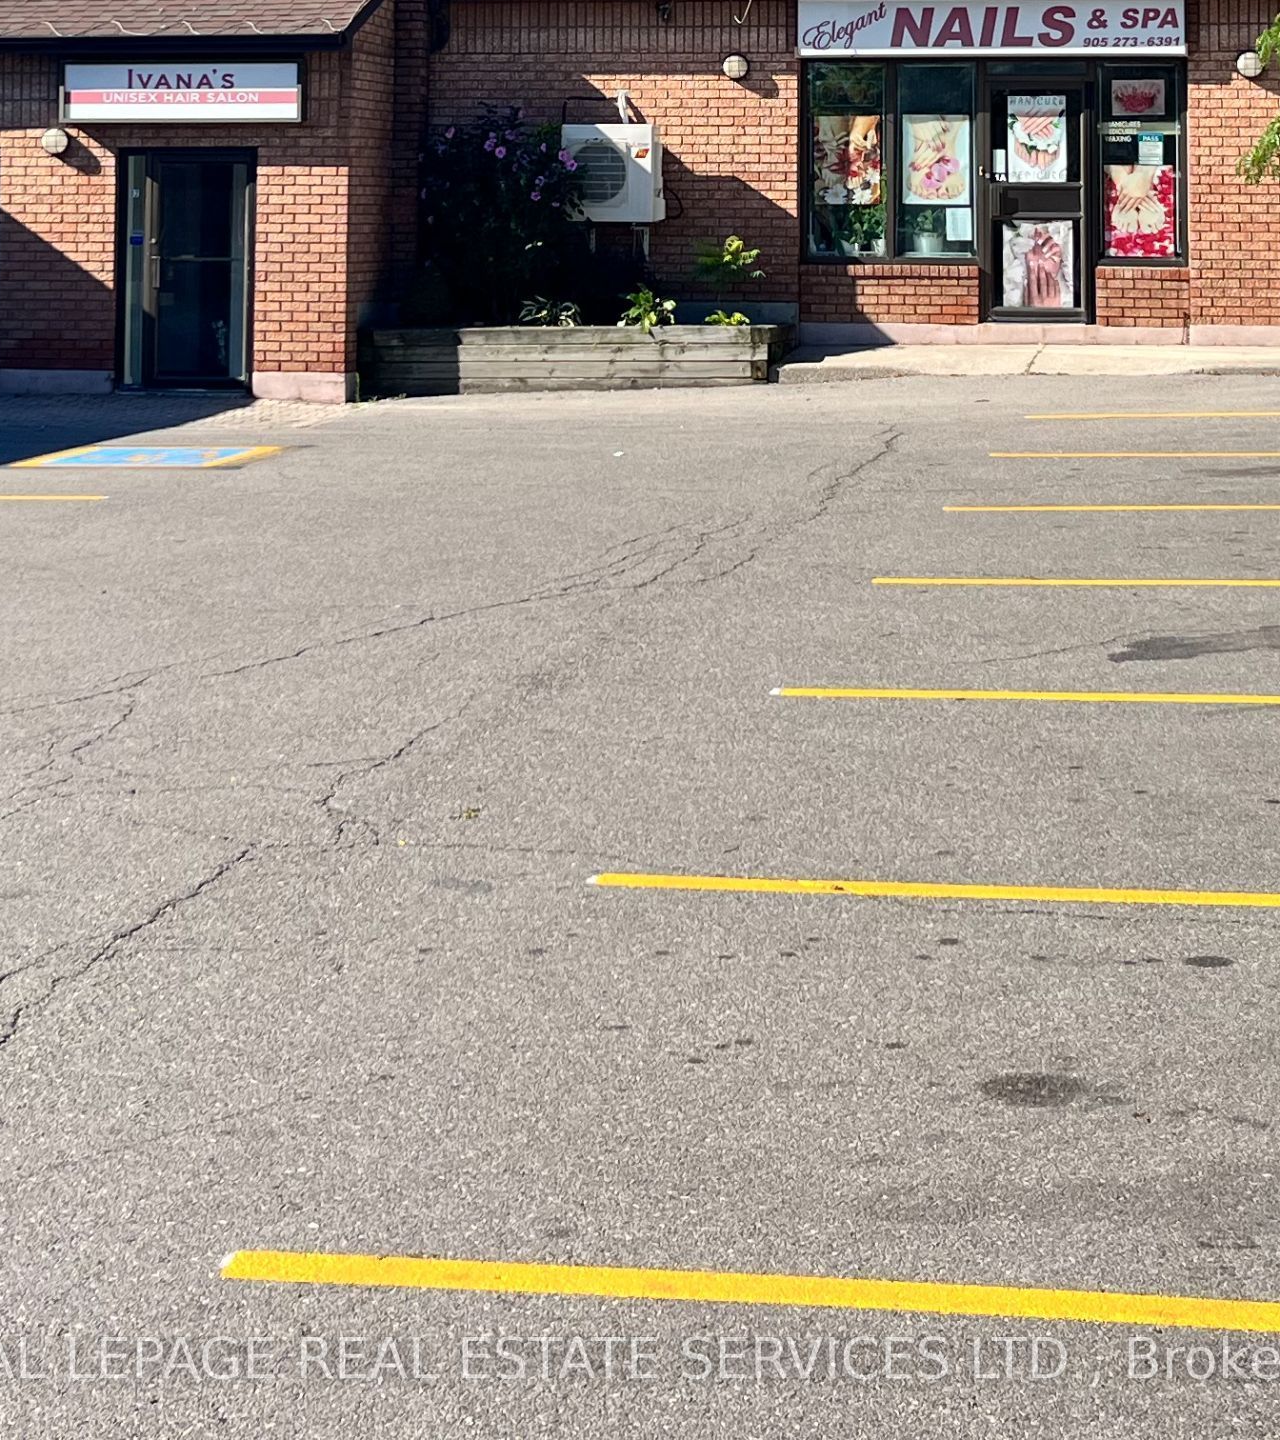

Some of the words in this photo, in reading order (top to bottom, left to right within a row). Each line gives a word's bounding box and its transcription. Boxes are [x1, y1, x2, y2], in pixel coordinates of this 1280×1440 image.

[803, 1, 887, 50] Elegant
[890, 6, 1076, 47] NAILS
[1086, 8, 1108, 29] &
[1120, 8, 1179, 29] SPA
[1083, 37, 1108, 48] 905
[1112, 36, 1181, 48] 273-6391
[103, 92, 158, 103] UNISEX
[164, 92, 201, 103] HAIR
[207, 91, 259, 103] SALON
